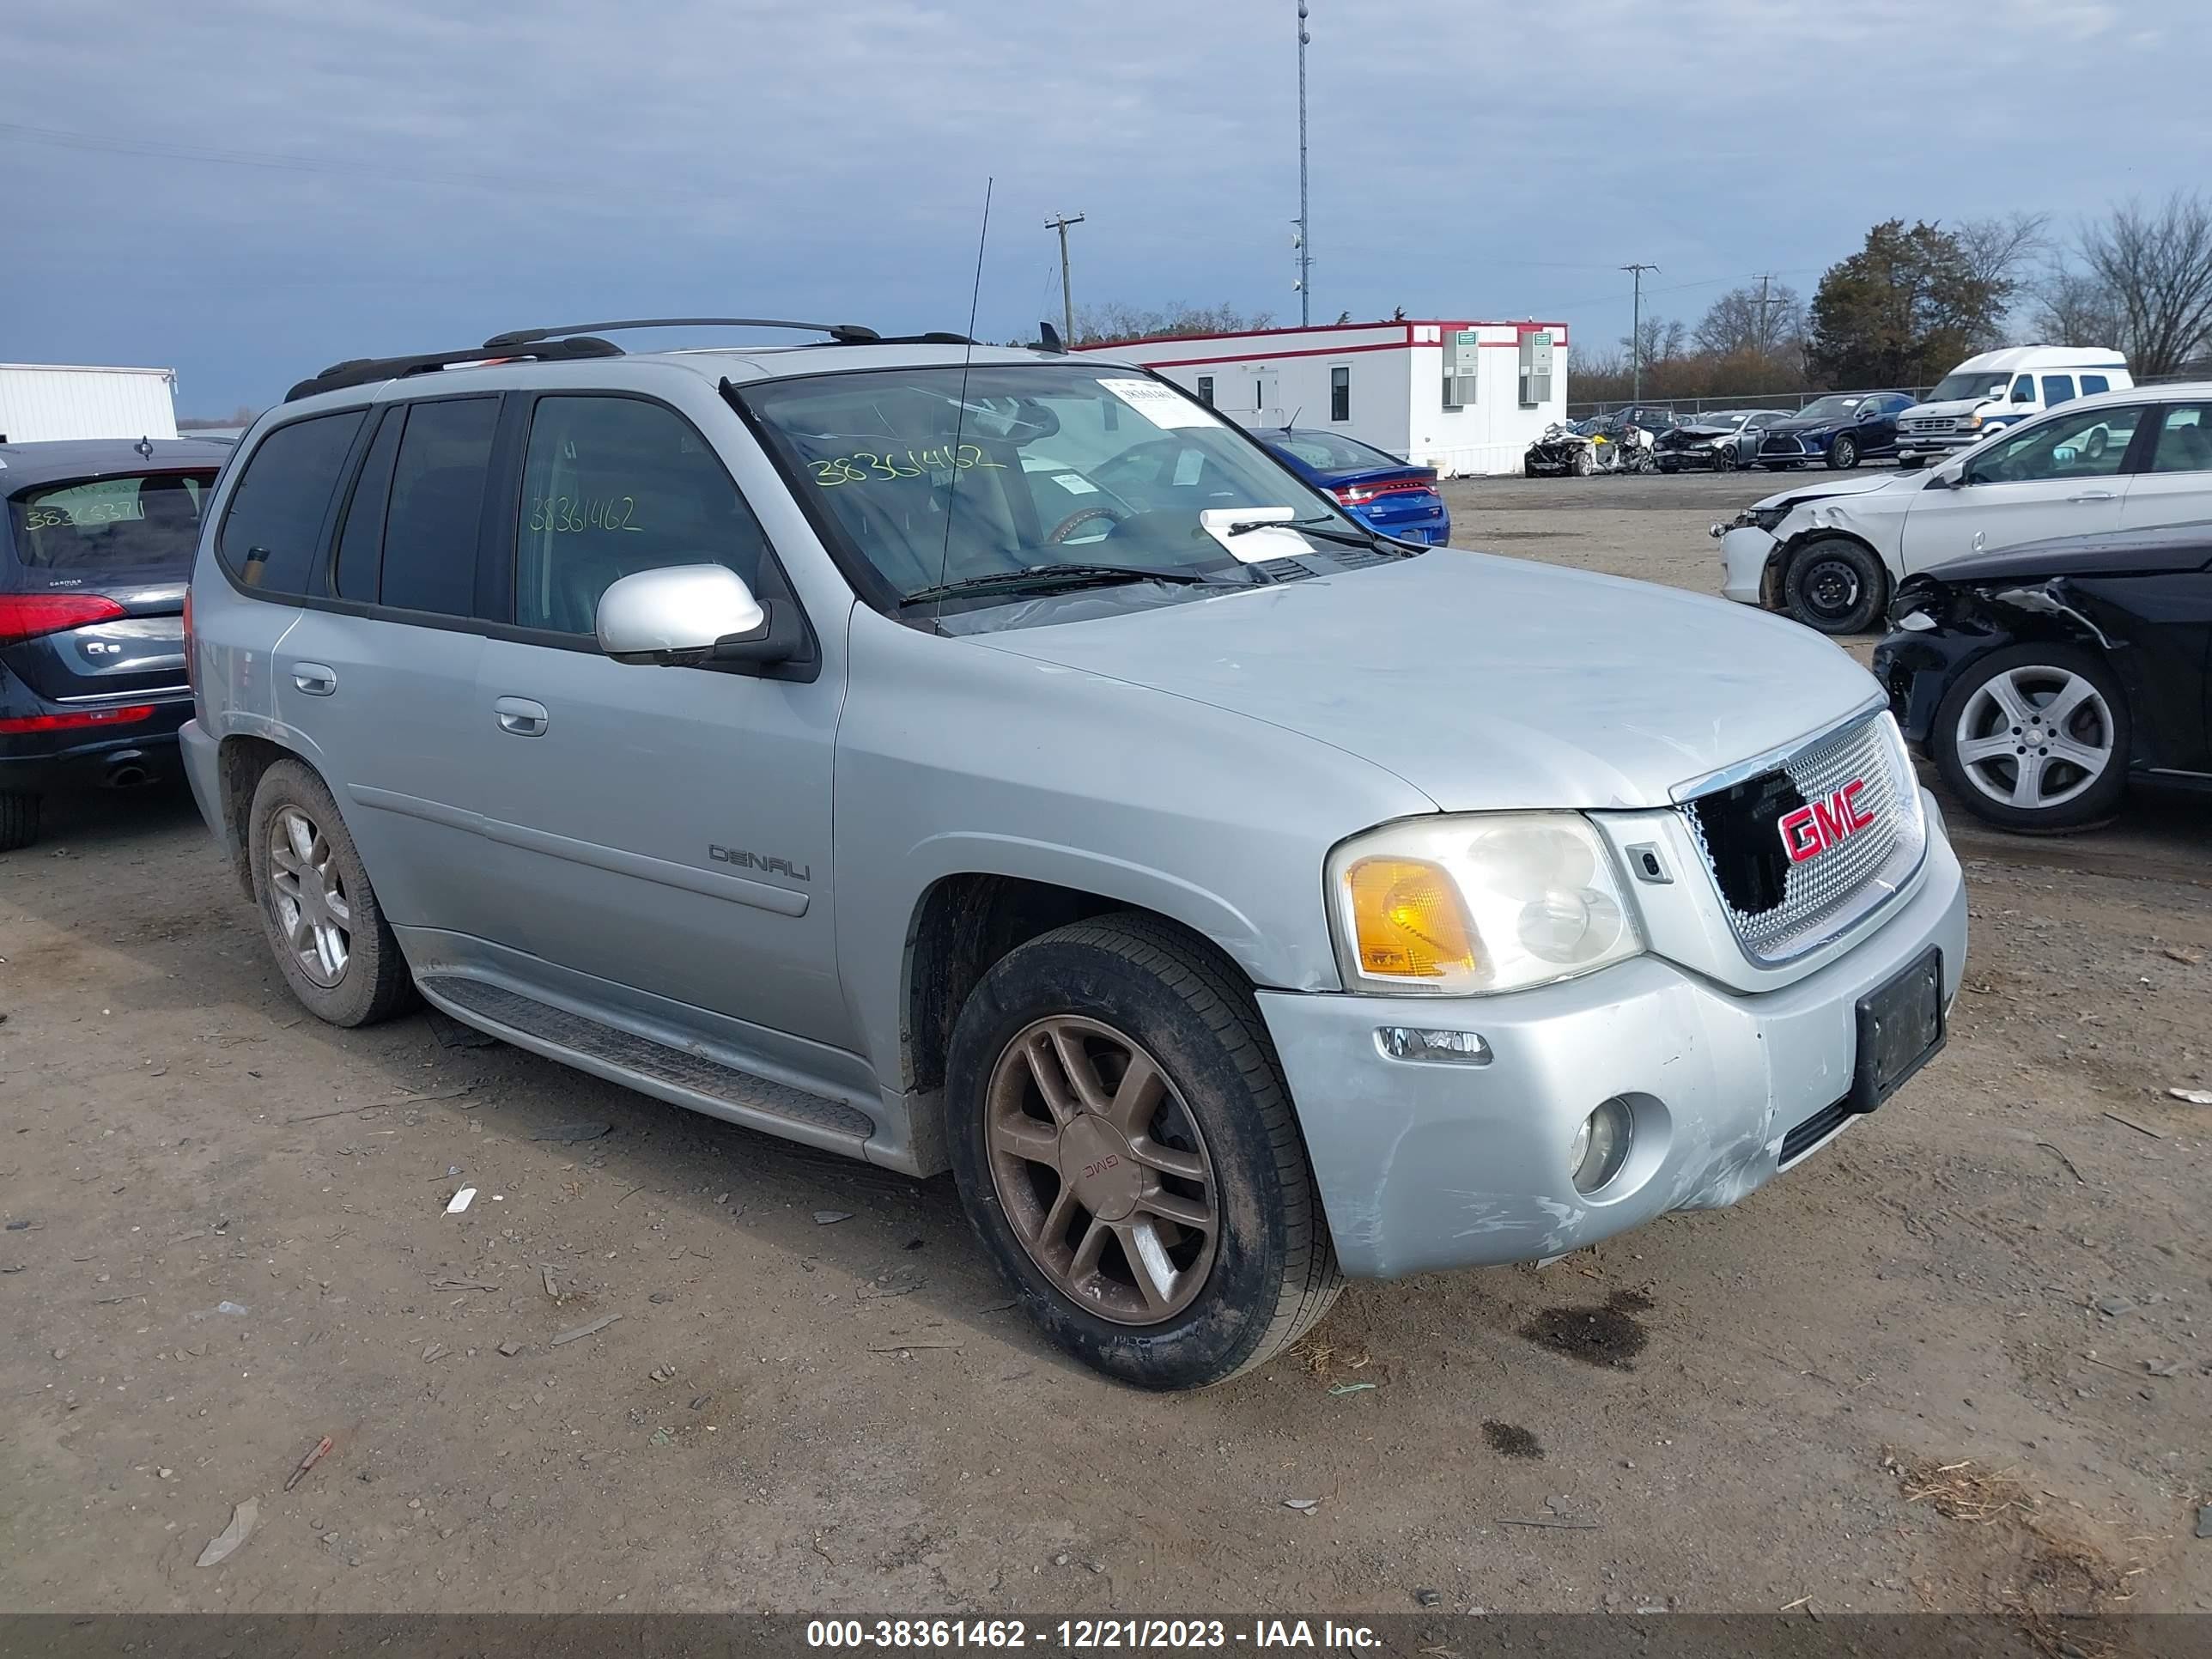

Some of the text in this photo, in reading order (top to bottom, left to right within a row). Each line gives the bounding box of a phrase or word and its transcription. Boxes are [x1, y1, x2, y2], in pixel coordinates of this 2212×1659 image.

[807, 445, 1008, 486] 38361462
[529, 496, 643, 532] 38361462
[1778, 776, 1875, 865] GMC
[708, 843, 811, 882] DENALI
[1082, 1154, 1119, 1178] GMC
